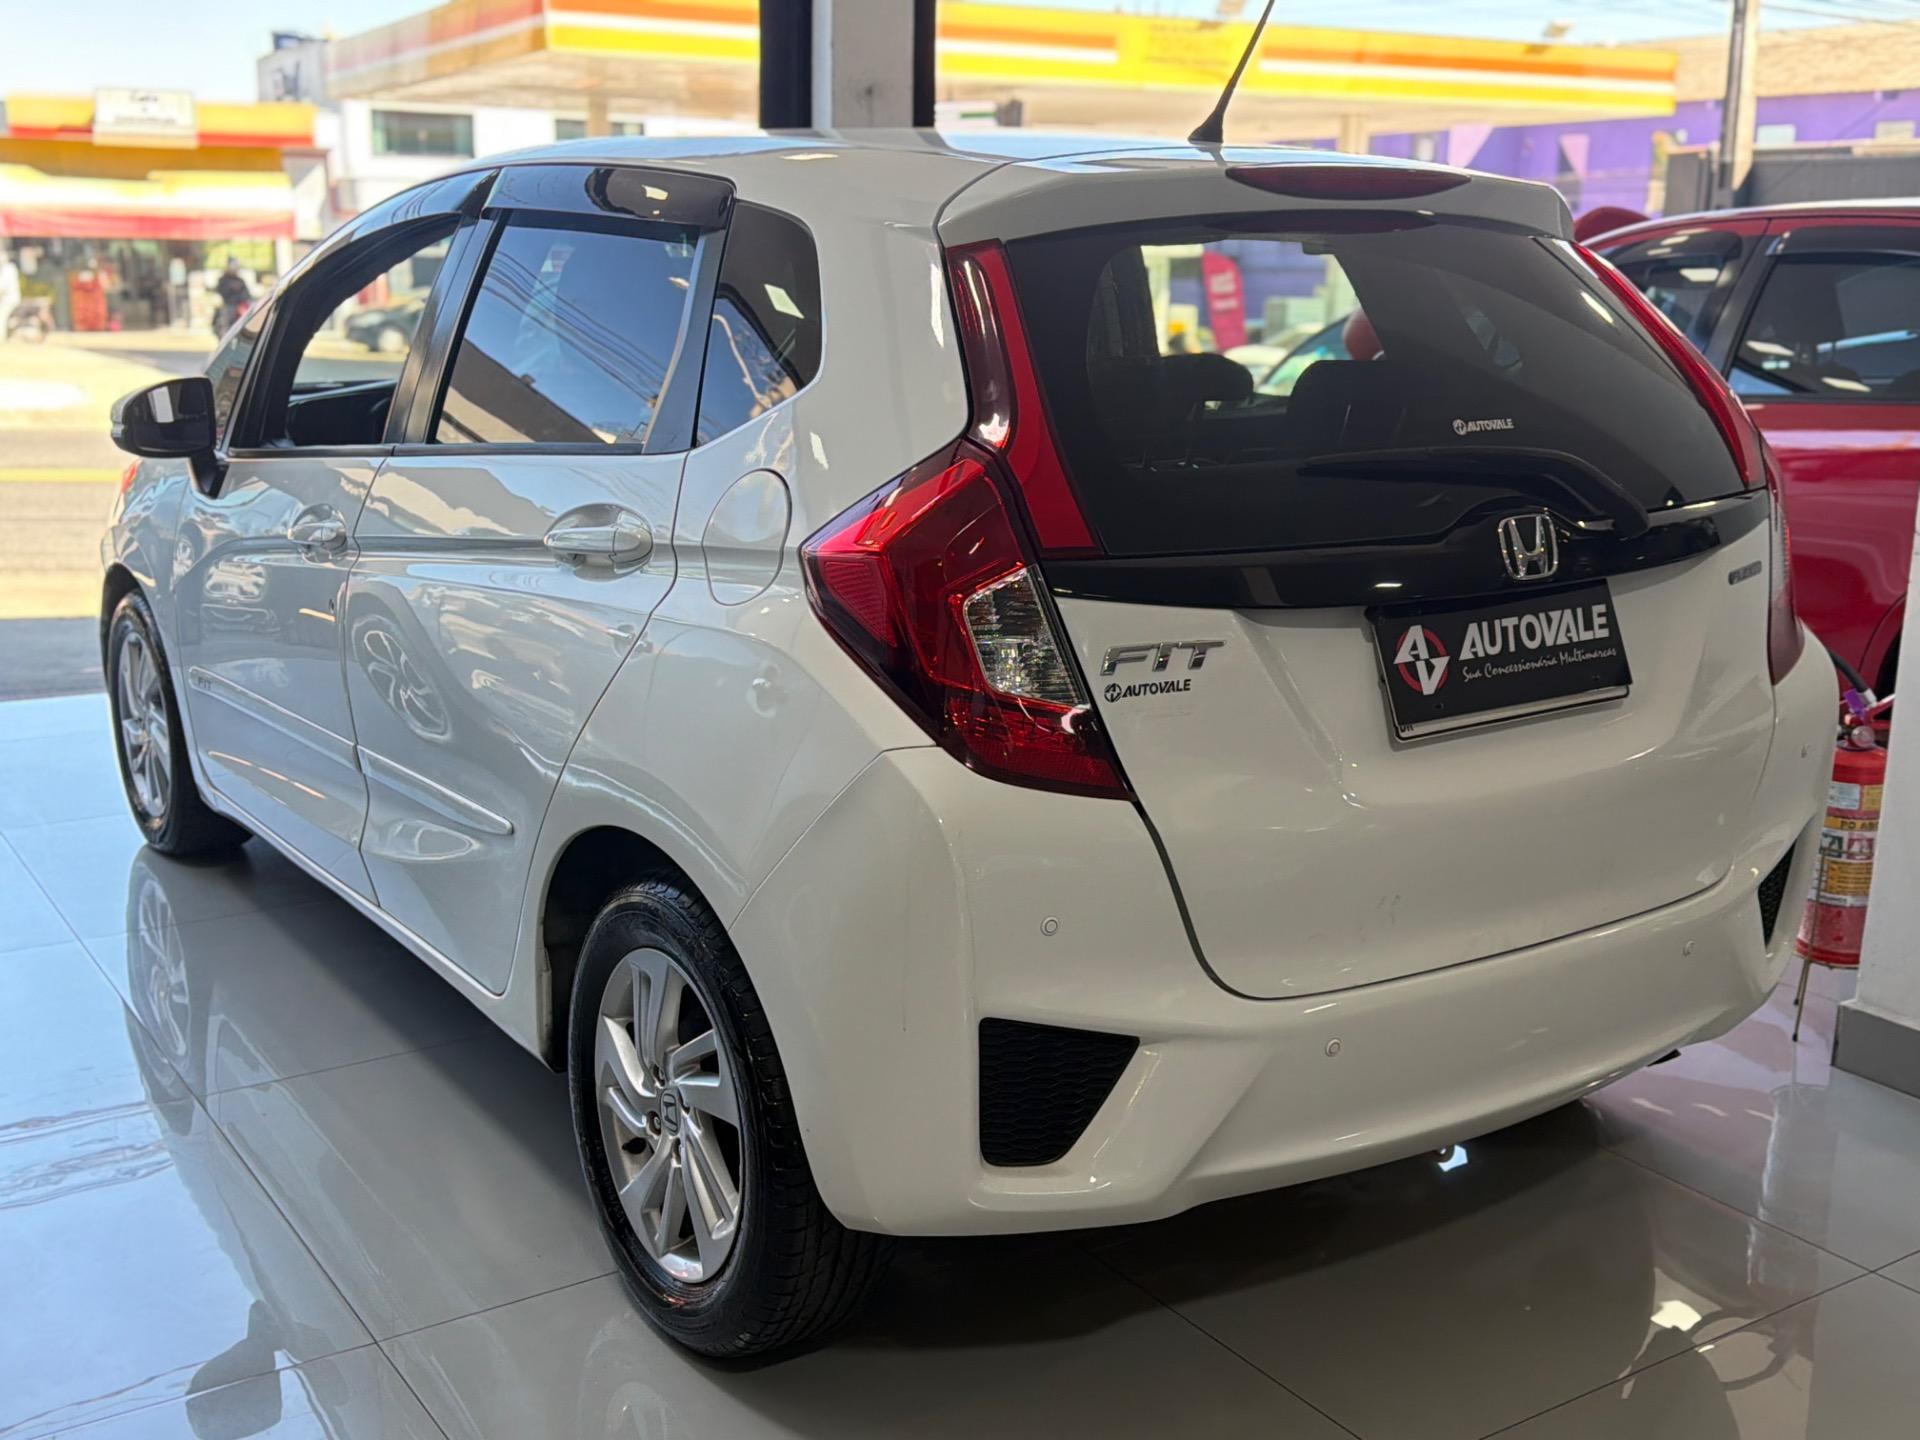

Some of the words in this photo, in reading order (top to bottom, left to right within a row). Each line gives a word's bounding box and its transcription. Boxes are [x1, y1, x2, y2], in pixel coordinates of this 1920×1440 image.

[1467, 418, 1515, 432] AUTOVALE
[1459, 603, 1610, 661] AUTOVALE
[1100, 639, 1227, 676] FIT
[1462, 664, 1483, 683] Sua
[1484, 655, 1558, 679] Concessionária
[1559, 646, 1618, 666] Multimarcas
[1122, 679, 1192, 698] AUTOVALE
